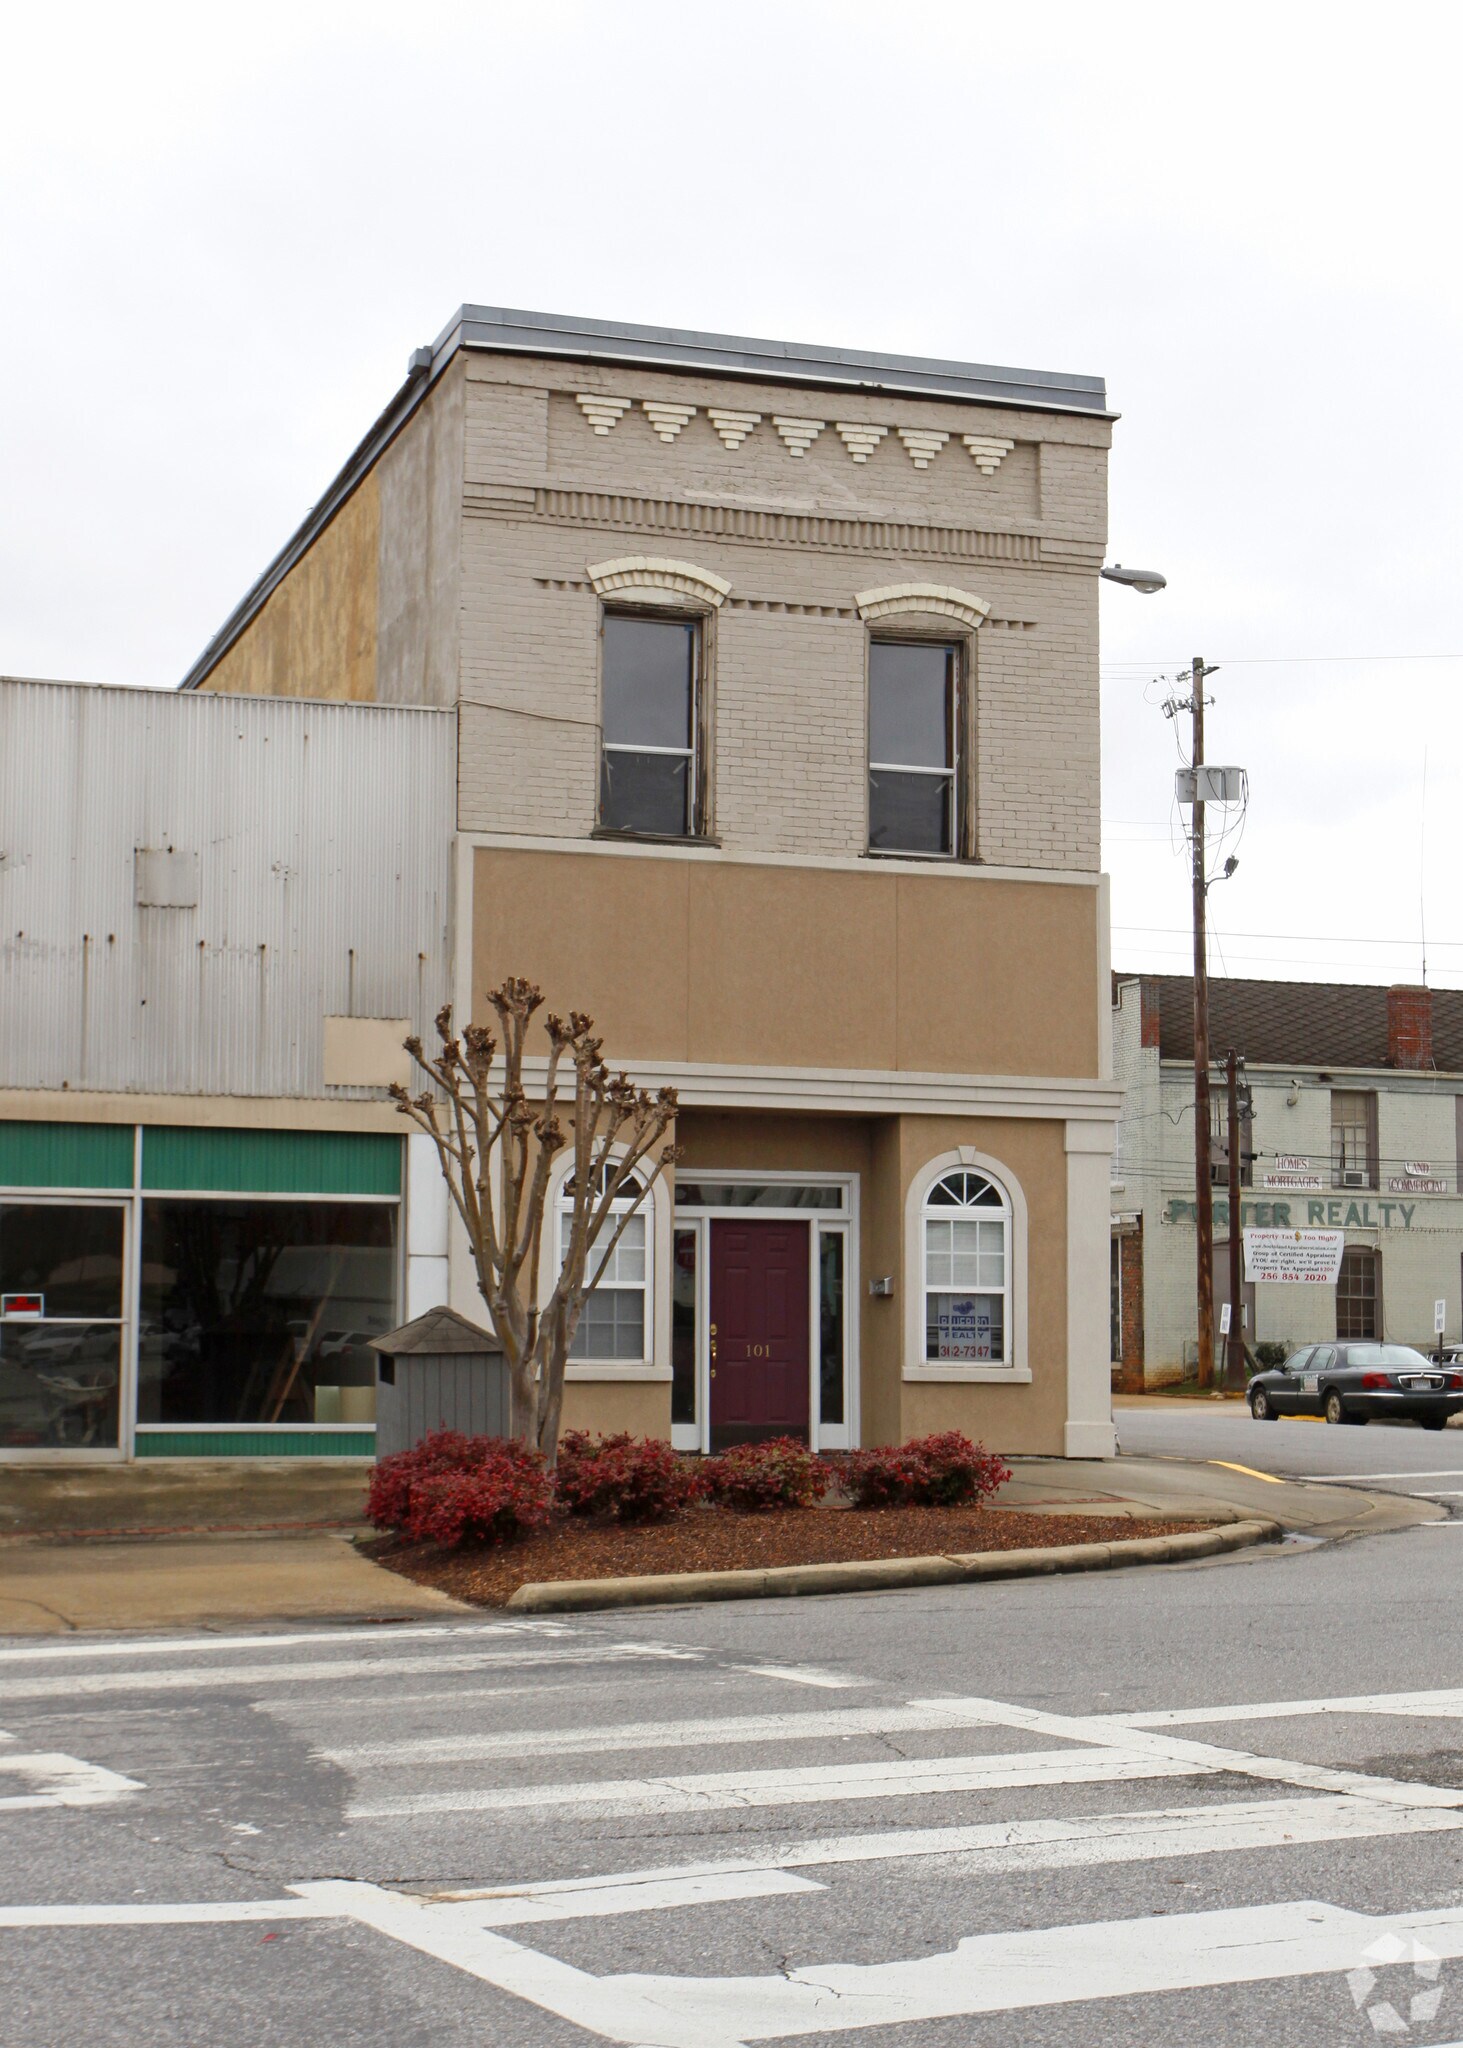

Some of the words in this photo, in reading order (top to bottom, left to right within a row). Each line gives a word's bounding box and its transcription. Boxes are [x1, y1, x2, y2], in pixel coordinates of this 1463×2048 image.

[1277, 1157, 1308, 1169] HOMES
[1266, 1175, 1320, 1188] MORTGAGES
[1390, 1179, 1444, 1192] COMMERCIAL
[1307, 1200, 1416, 1228] REALTY
[1250, 1233, 1279, 1241] Property
[1282, 1273, 1299, 1281] 854
[746, 1344, 770, 1358] 101
